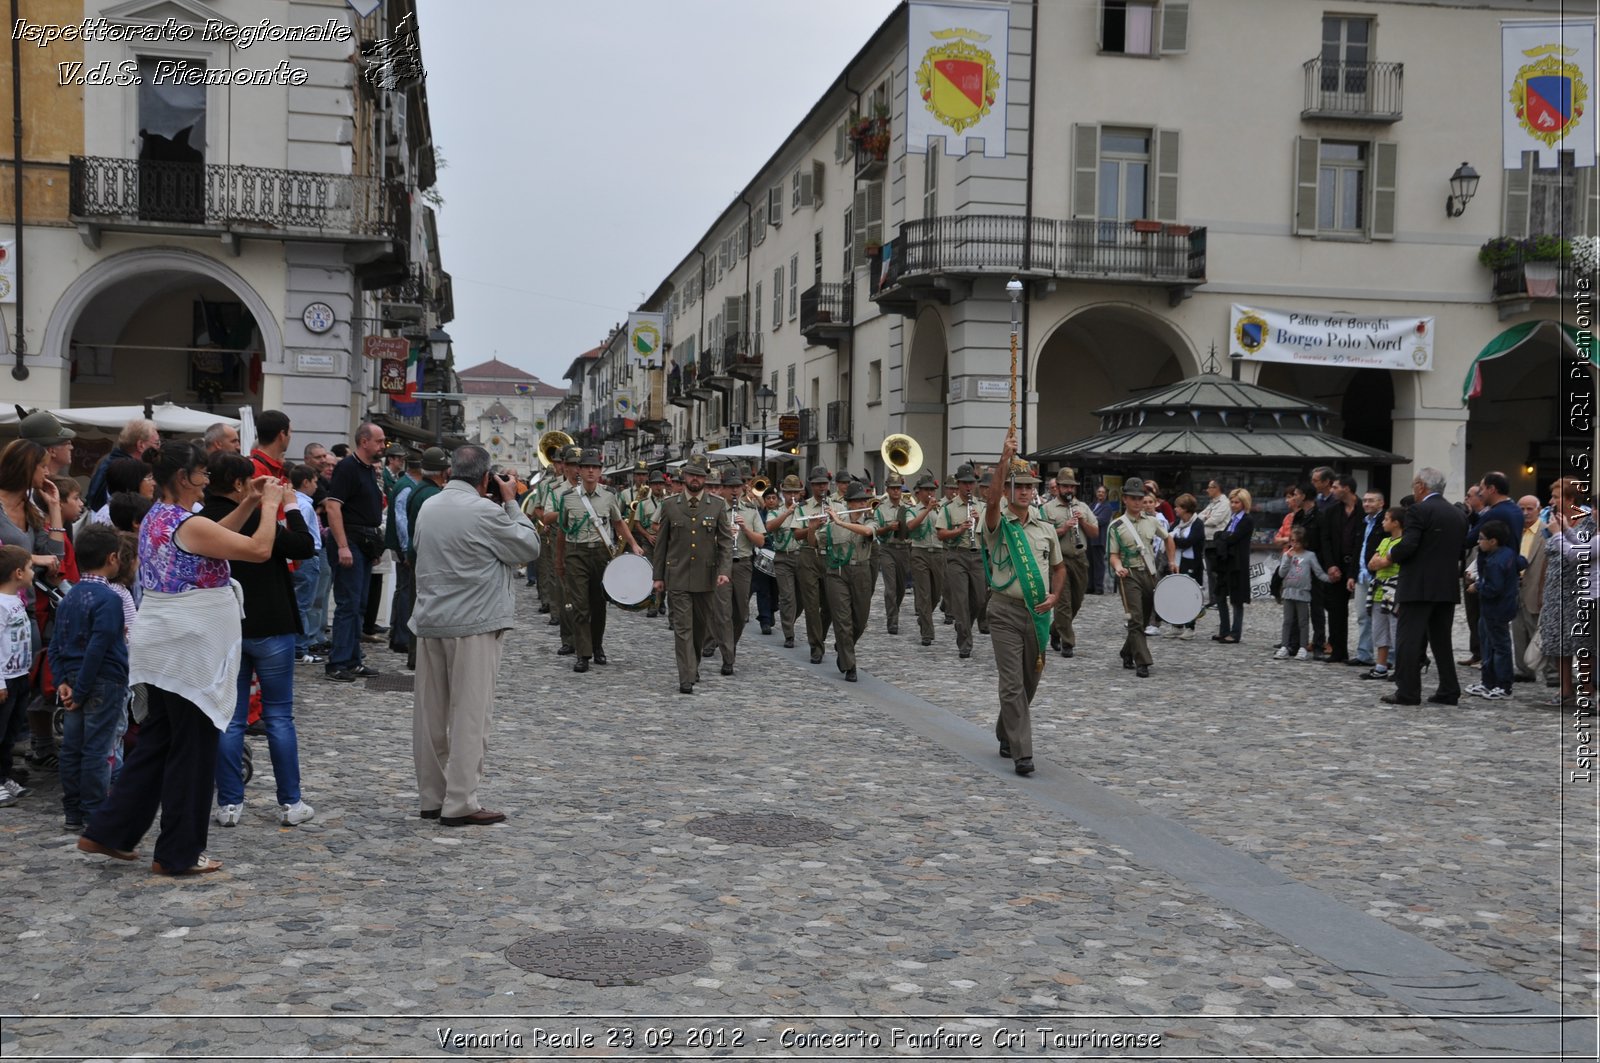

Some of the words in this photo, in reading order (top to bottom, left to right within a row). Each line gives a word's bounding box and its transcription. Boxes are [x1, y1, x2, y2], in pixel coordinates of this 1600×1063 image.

[1289, 313, 1318, 328] Palio
[1324, 317, 1342, 327] dei
[1347, 318, 1389, 333] Borghi
[1276, 329, 1323, 351] Borgo
[1327, 332, 1361, 349] Polo
[1366, 334, 1403, 351] Nord
